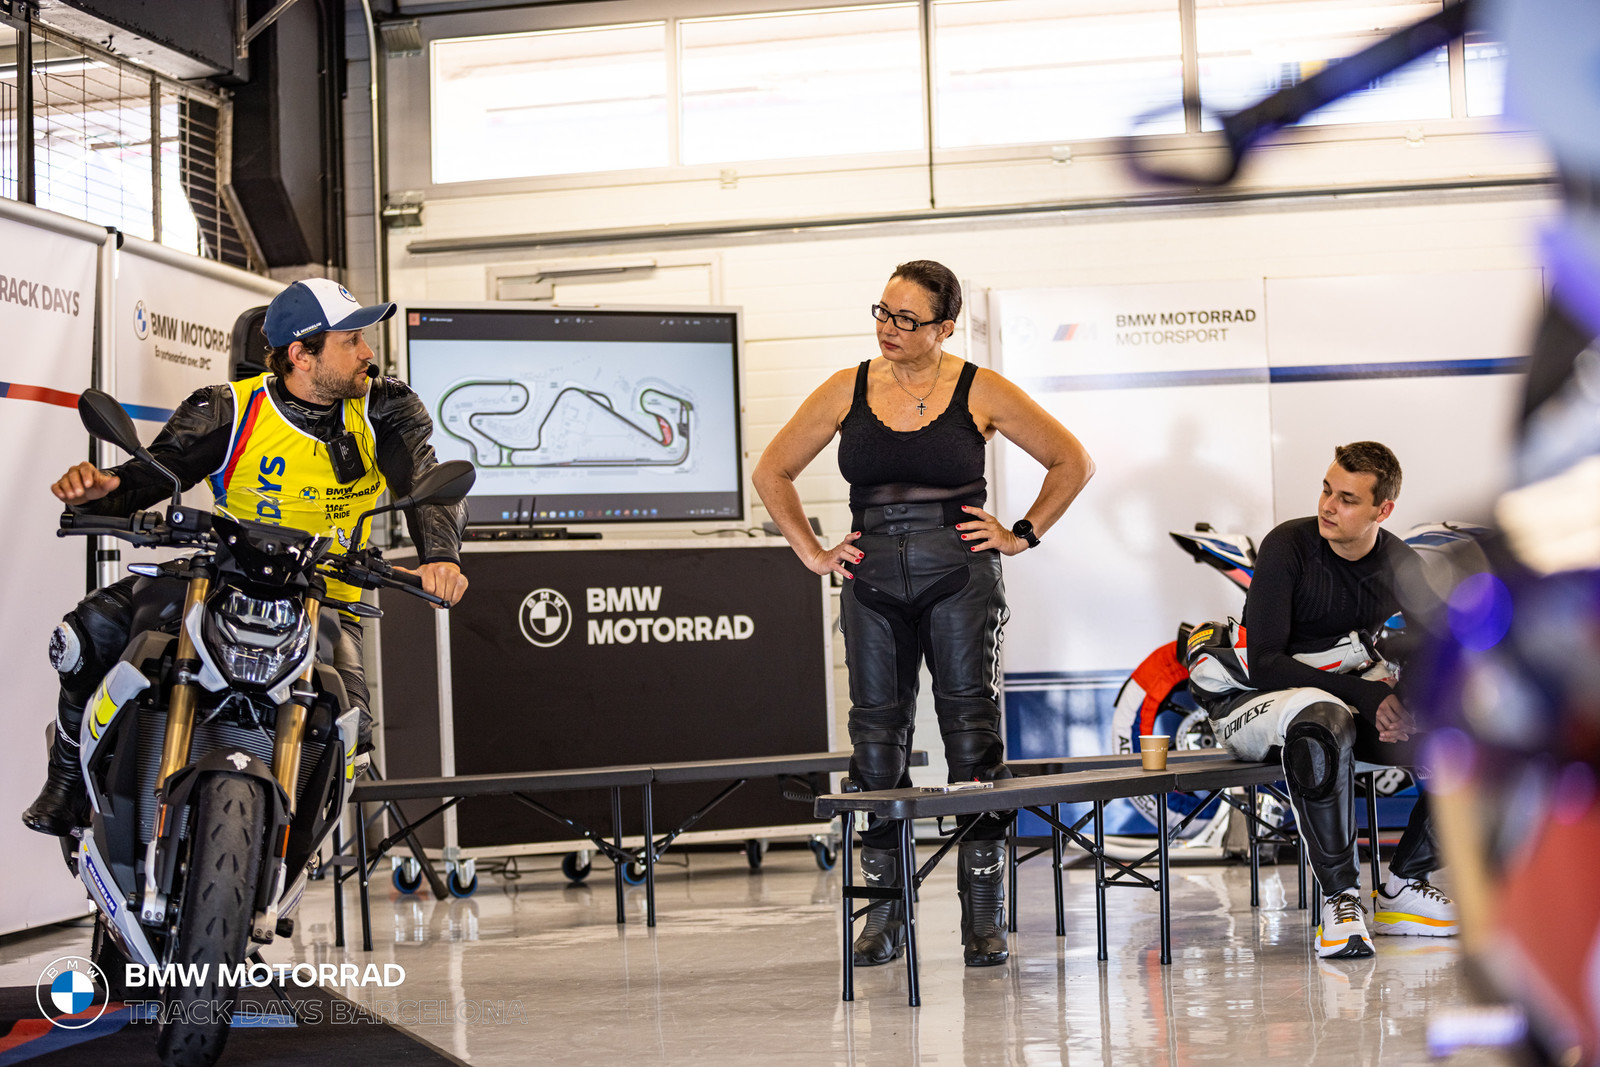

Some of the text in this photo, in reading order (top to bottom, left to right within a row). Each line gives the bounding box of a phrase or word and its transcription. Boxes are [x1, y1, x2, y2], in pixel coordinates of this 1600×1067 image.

[42, 285, 80, 317] DAYS
[150, 311, 178, 341] BMW
[1116, 309, 1257, 328] BMW MOTORRAD
[1116, 328, 1229, 346] MOTORSPORT
[326, 487, 353, 496] BMW
[333, 510, 350, 520] RIDE
[586, 586, 662, 613] BMW
[587, 615, 755, 645] MOTORRAD
[1224, 699, 1275, 740] DAINESE
[88, 862, 116, 911] MICHELIN
